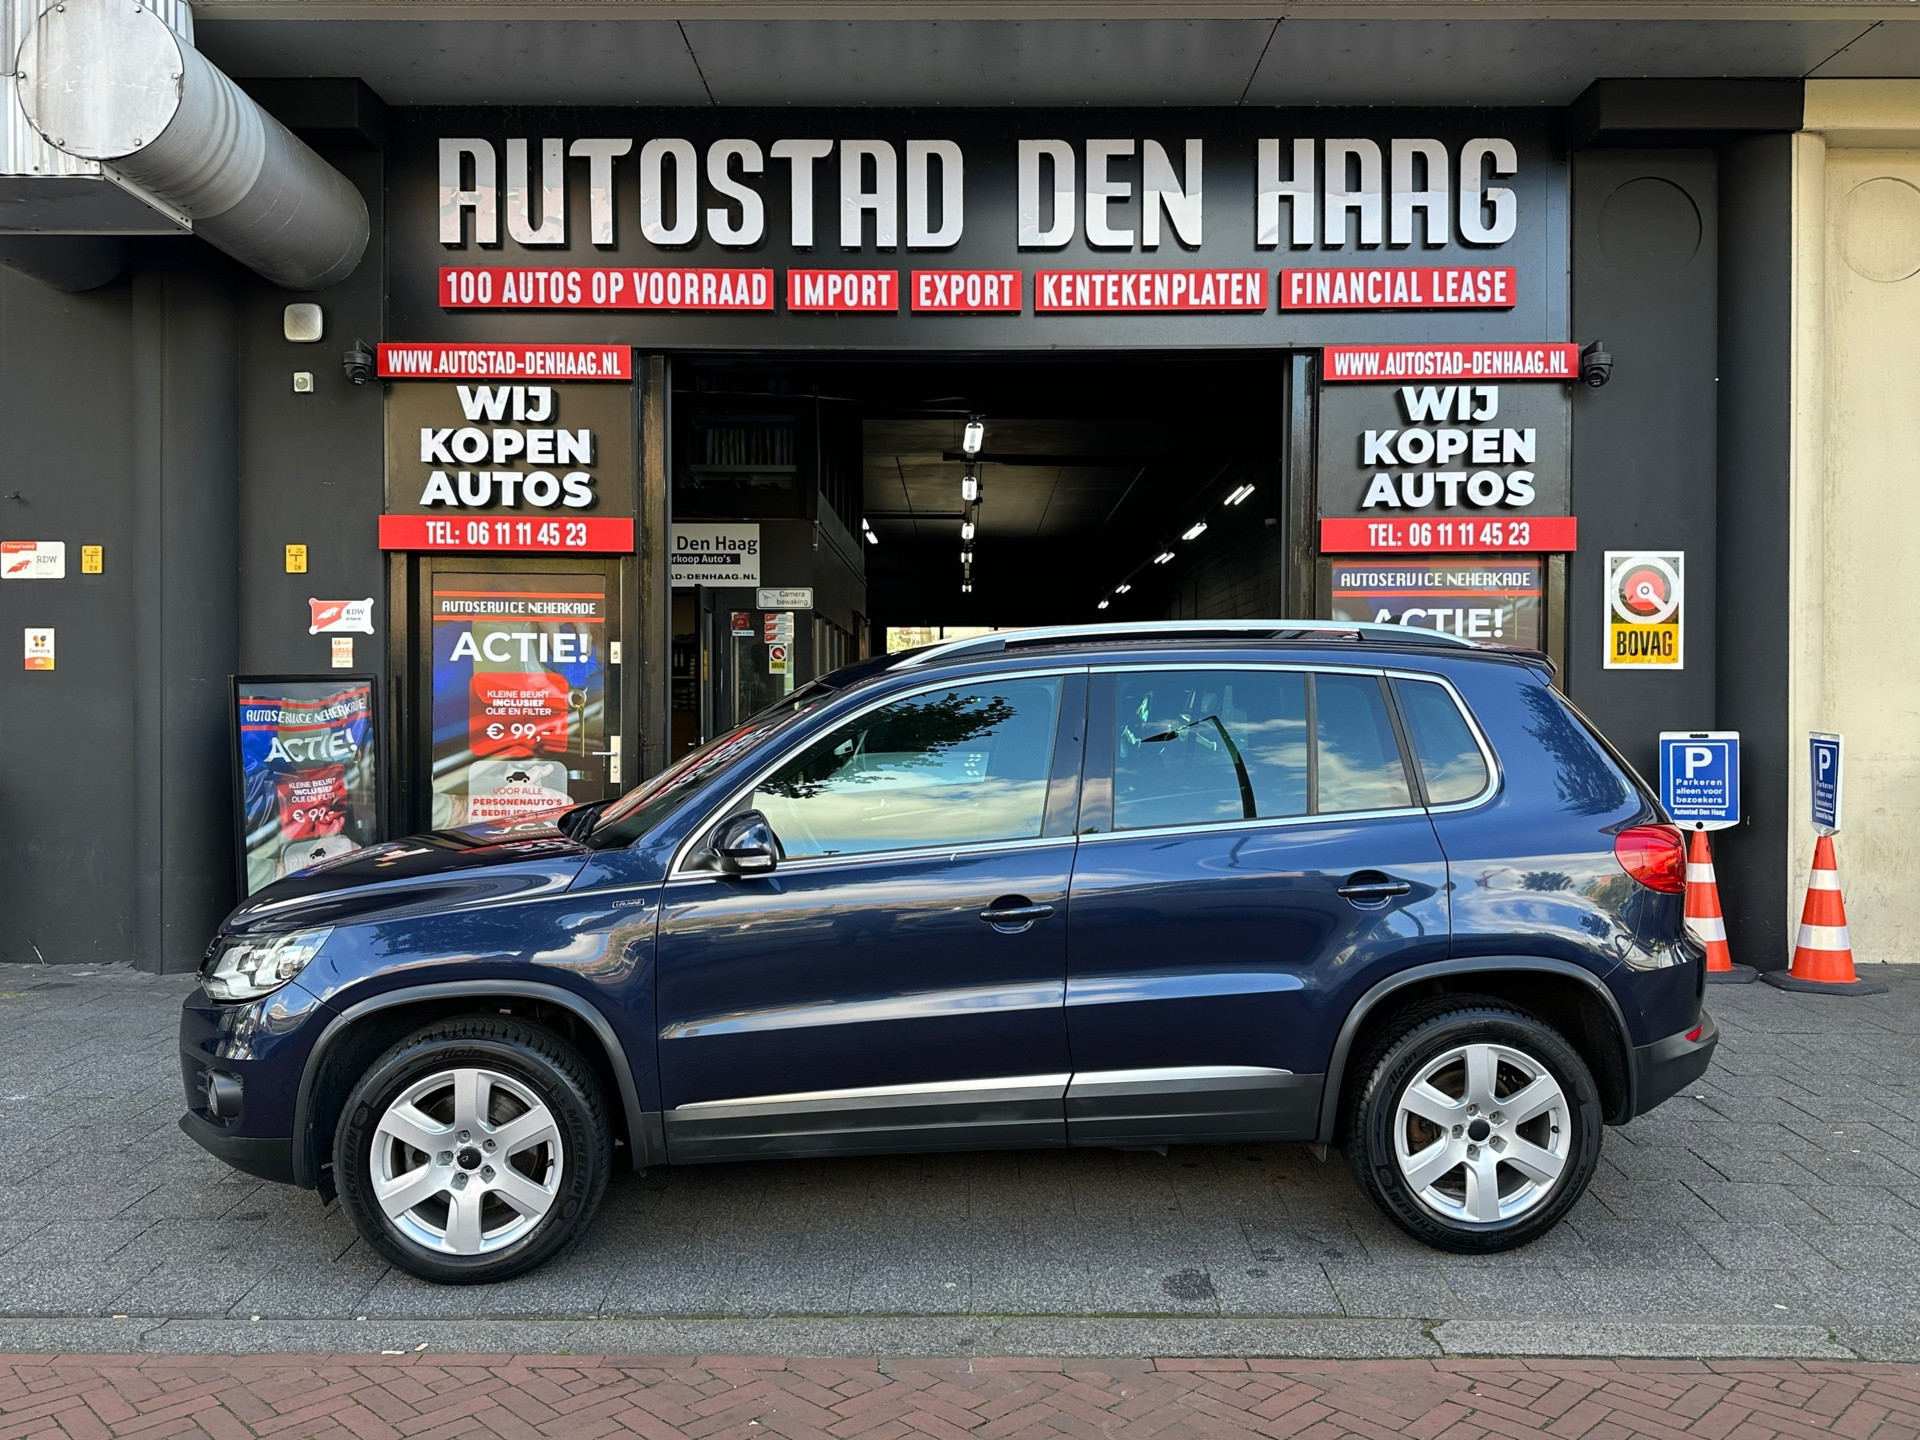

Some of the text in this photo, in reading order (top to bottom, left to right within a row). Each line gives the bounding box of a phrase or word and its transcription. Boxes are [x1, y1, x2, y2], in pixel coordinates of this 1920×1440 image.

[438, 138, 1518, 247] AUTOSTAD DEN HAAG
[446, 270, 768, 306] 100 AUTOS OP VOORRAAD
[793, 273, 892, 306] IMPORT
[919, 273, 1014, 306] EXPORT
[1042, 272, 1262, 306] KENTEKENPLATEN
[1291, 270, 1508, 305] FINANCIAL LEASE
[387, 349, 622, 376] WWW.AUTOSTAD-DENHAAG.NL
[1334, 350, 1569, 376] WWW.AUTOSTAD-DENHAAG.NL
[456, 385, 552, 422] WIJ
[1401, 385, 1499, 421] WIJ
[420, 427, 591, 464] KOPEN
[1363, 428, 1536, 464] KOPEN
[419, 470, 593, 508] AUTOS
[1362, 470, 1536, 508] AUTOS
[426, 521, 587, 546] TEL: 06 11 11 45 23
[676, 536, 758, 555] Den Haag
[1368, 522, 1530, 546] TEL: 06 11 11 45 23
[36, 555, 57, 563] RDW
[671, 554, 731, 564] rkoop Auto's
[1340, 572, 1531, 587] AUTOSERVICE NEHERKADE
[441, 600, 596, 615] AUTOSERVICE NEHERKADE
[450, 631, 589, 664] ACTIE!
[1616, 630, 1673, 656] BOVAG
[487, 690, 550, 698] KLEINE BEURT
[492, 699, 545, 707] INCLUSIEF
[485, 707, 552, 716] OLIE EN FILTER
[263, 727, 358, 763] ACTIE!
[486, 722, 551, 742] € 99,-
[1685, 747, 1713, 779] P
[1819, 748, 1831, 780] P
[493, 787, 520, 795] VOOR
[1676, 778, 1723, 786] Parkeren
[473, 798, 563, 806] PERSONENAUTO'S
[1699, 808, 1710, 816] Den
[1711, 808, 1726, 817] Haag
[292, 809, 306, 823] €
[566, 1108, 588, 1197] MICHELIN
